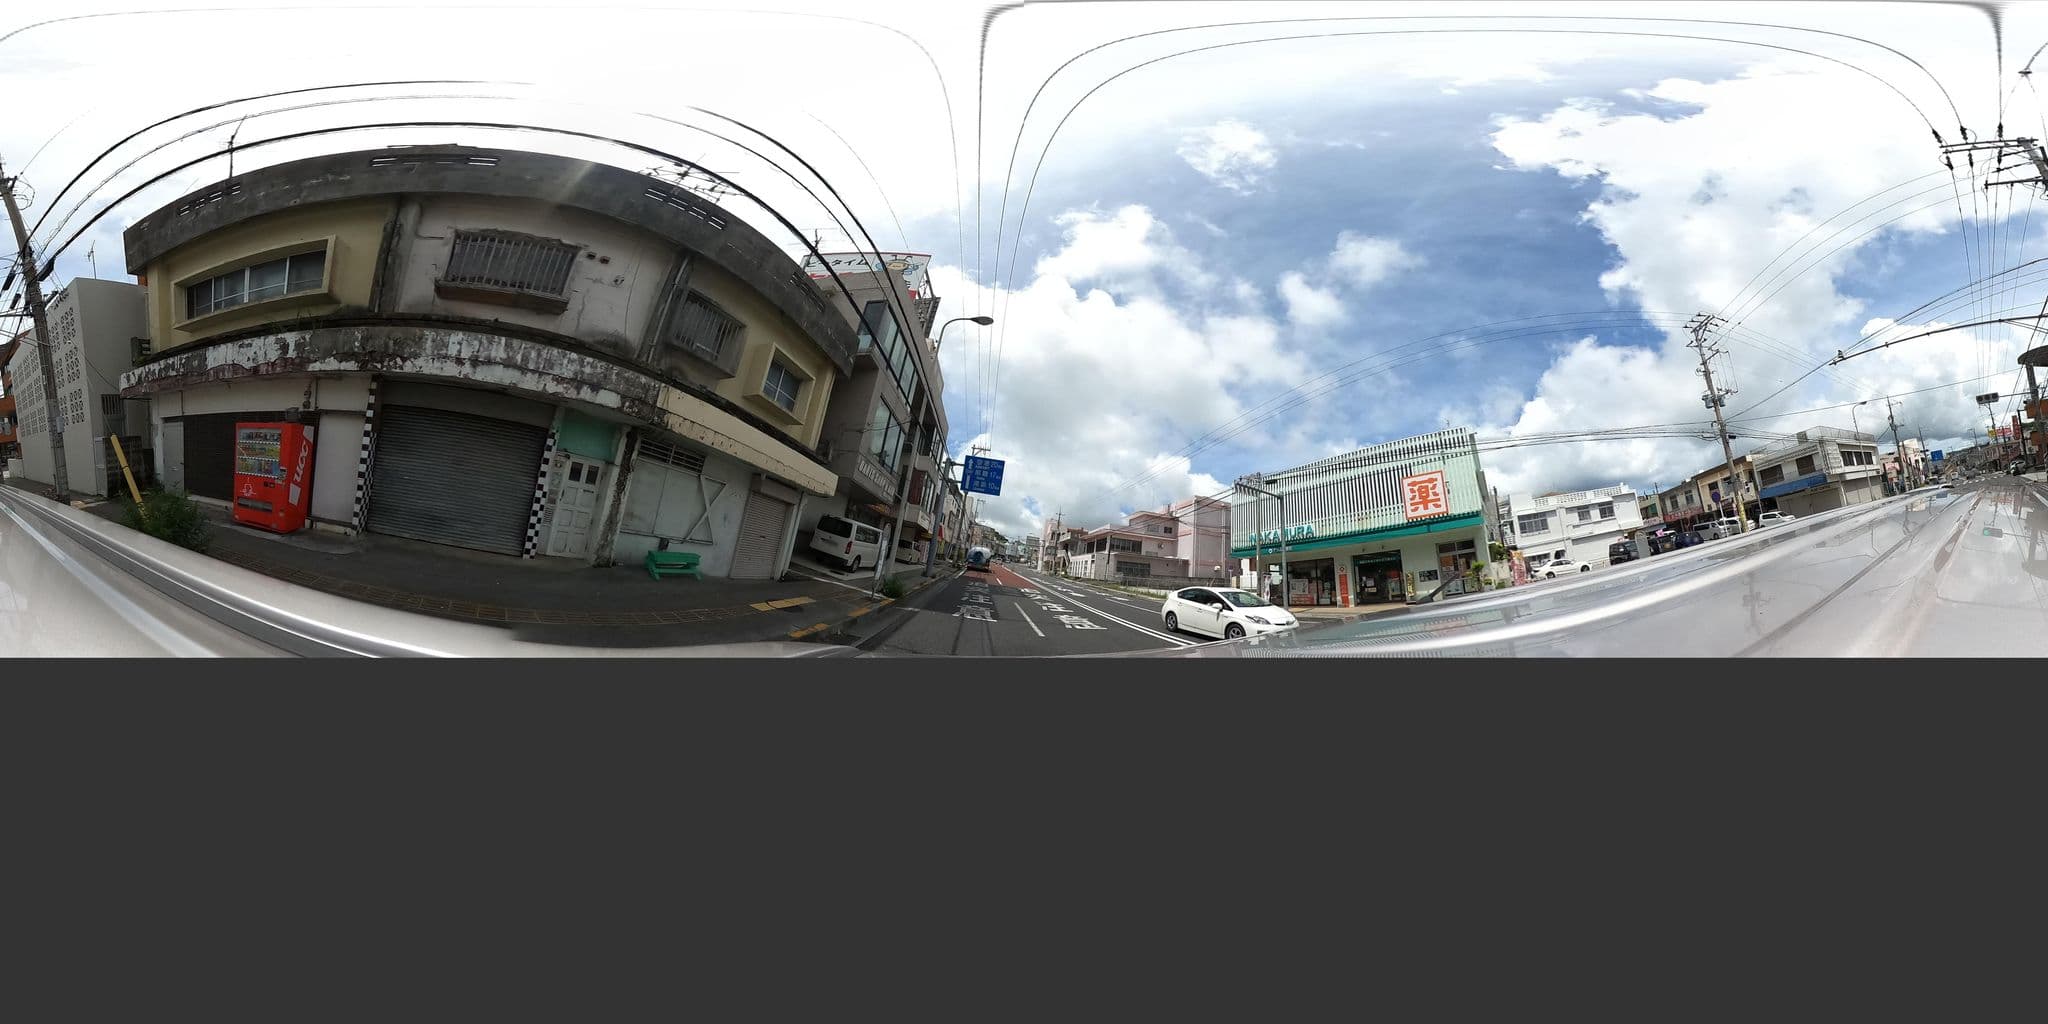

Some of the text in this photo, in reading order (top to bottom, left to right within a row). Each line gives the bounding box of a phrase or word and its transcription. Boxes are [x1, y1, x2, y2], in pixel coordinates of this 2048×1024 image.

[293, 440, 308, 482] UCC
[1407, 477, 1442, 513] 薬
[1248, 524, 1315, 544] NAKAMURA
